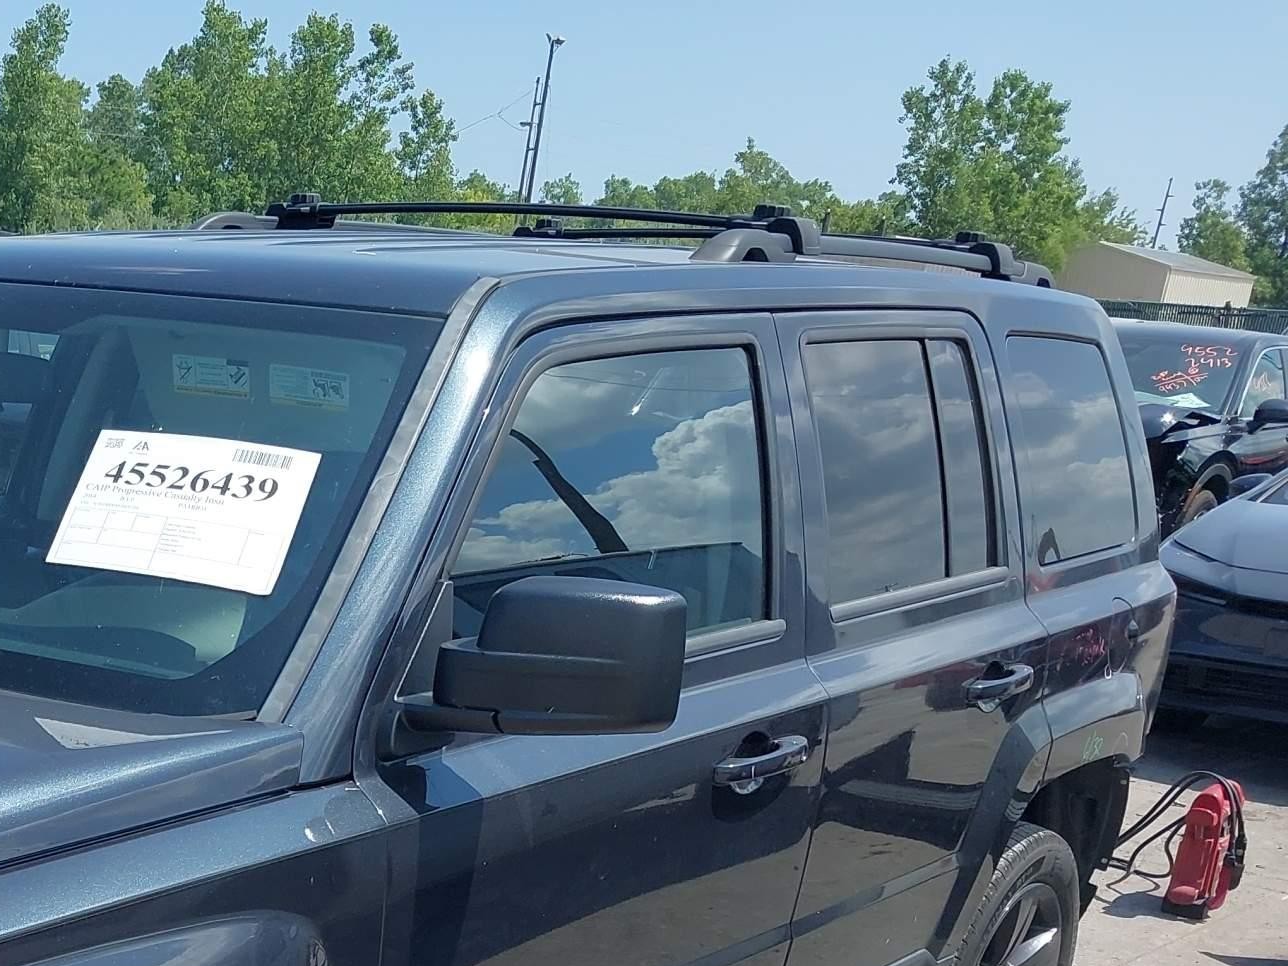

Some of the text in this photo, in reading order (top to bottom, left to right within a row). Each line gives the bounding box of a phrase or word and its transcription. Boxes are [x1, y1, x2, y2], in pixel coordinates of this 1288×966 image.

[85, 483, 111, 492] CAIP
[112, 486, 162, 498] Progressive
[164, 490, 202, 503] Casualty
[103, 460, 279, 502] 45526439
